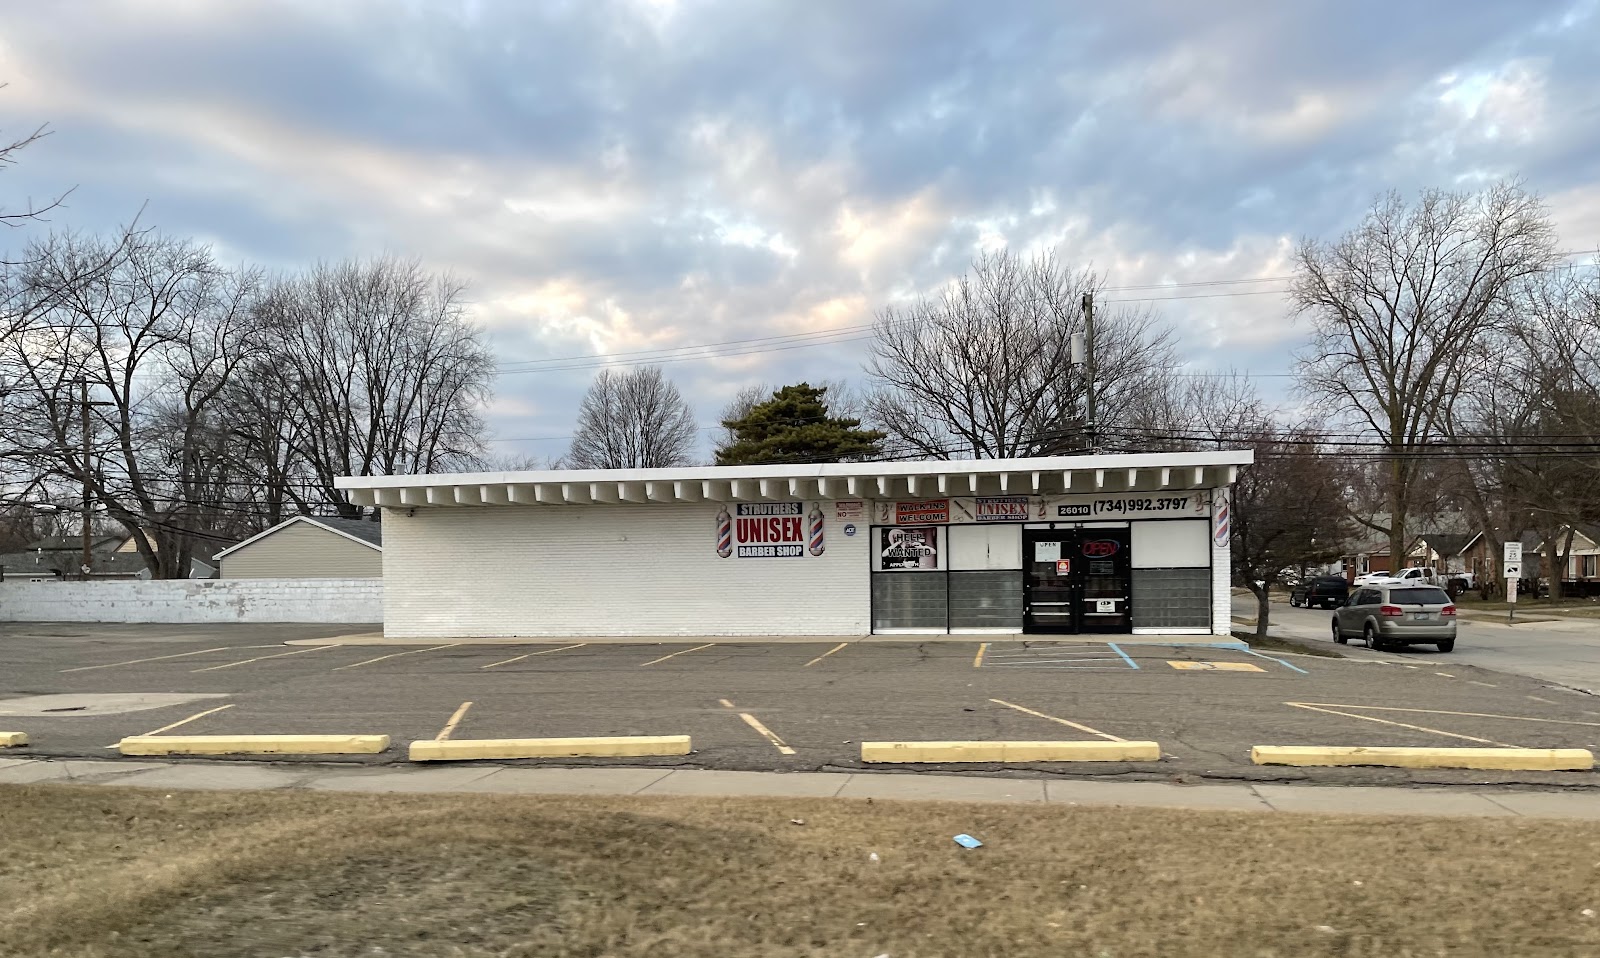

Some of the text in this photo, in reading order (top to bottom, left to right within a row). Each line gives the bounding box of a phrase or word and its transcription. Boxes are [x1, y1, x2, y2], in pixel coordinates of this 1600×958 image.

[741, 503, 799, 515] STRUTHERS
[977, 503, 1027, 515] UNISEX
[1060, 498, 1188, 515] 26010 (734)992.3797
[899, 513, 946, 522] WELCOME
[736, 517, 804, 543] UNISEX
[896, 533, 925, 542] HELP
[739, 546, 802, 557] BARBER SHOP
[888, 548, 931, 557] WANTED
[1083, 542, 1116, 555] OPEN
